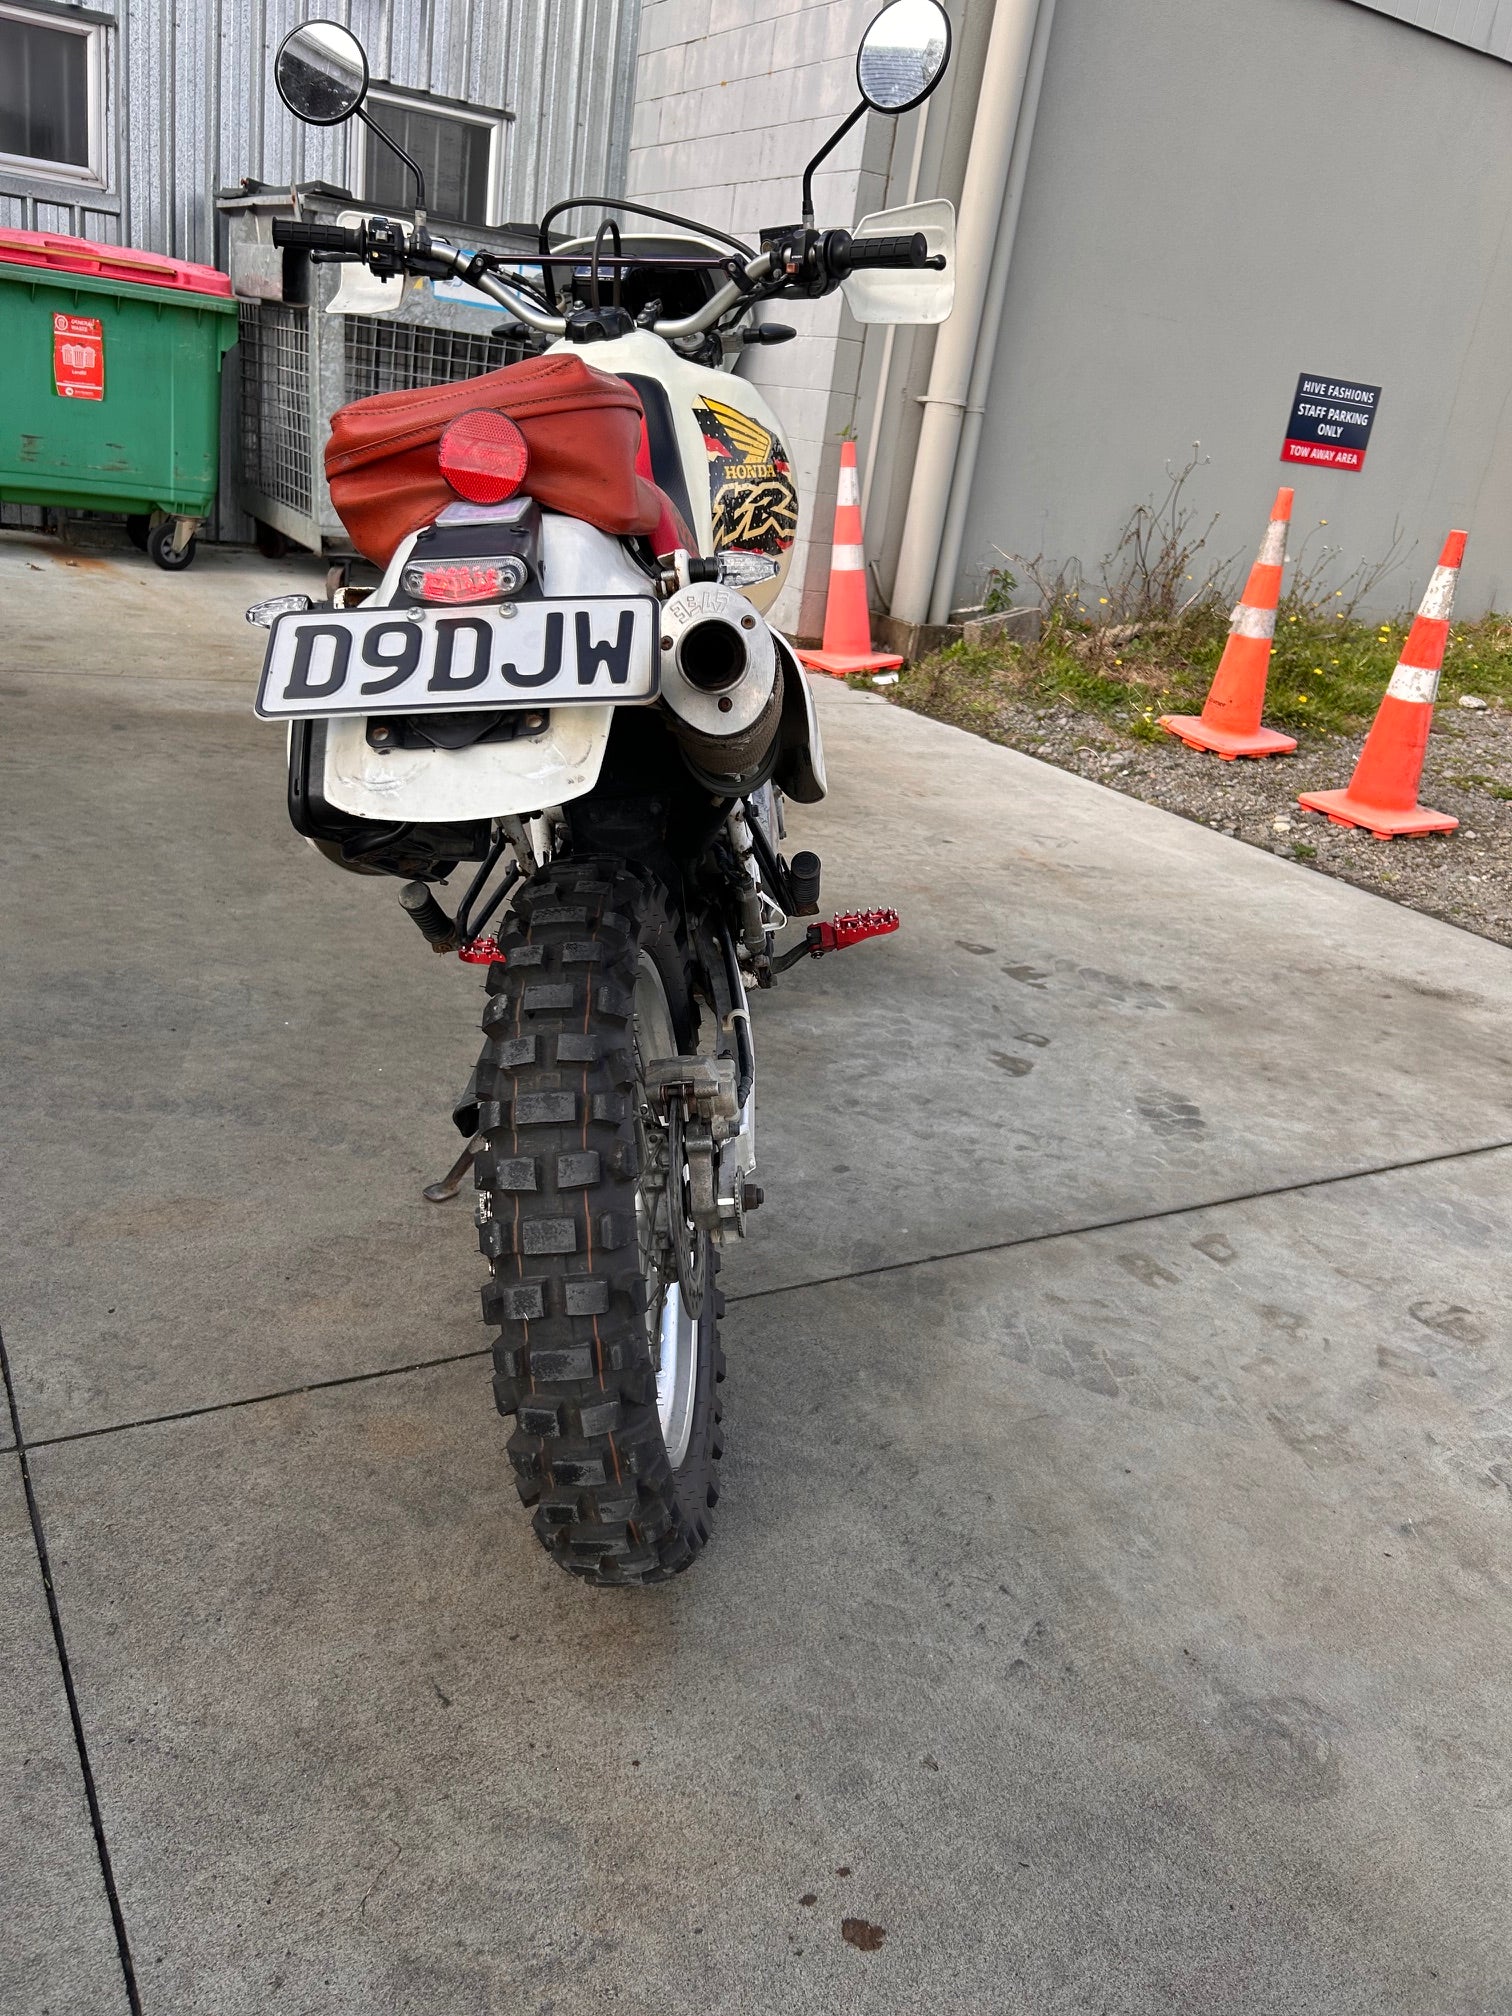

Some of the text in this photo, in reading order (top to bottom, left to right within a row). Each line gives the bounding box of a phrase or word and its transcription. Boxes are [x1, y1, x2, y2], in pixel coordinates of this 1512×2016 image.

[1303, 381, 1375, 403] HIVE FASHIONS
[1297, 403, 1369, 426] STAFF PARKING
[1317, 423, 1344, 438] ONLY
[1290, 445, 1358, 465] TOW AWAY AREA
[724, 463, 777, 480] HONDA
[282, 610, 636, 701] D9DJW
